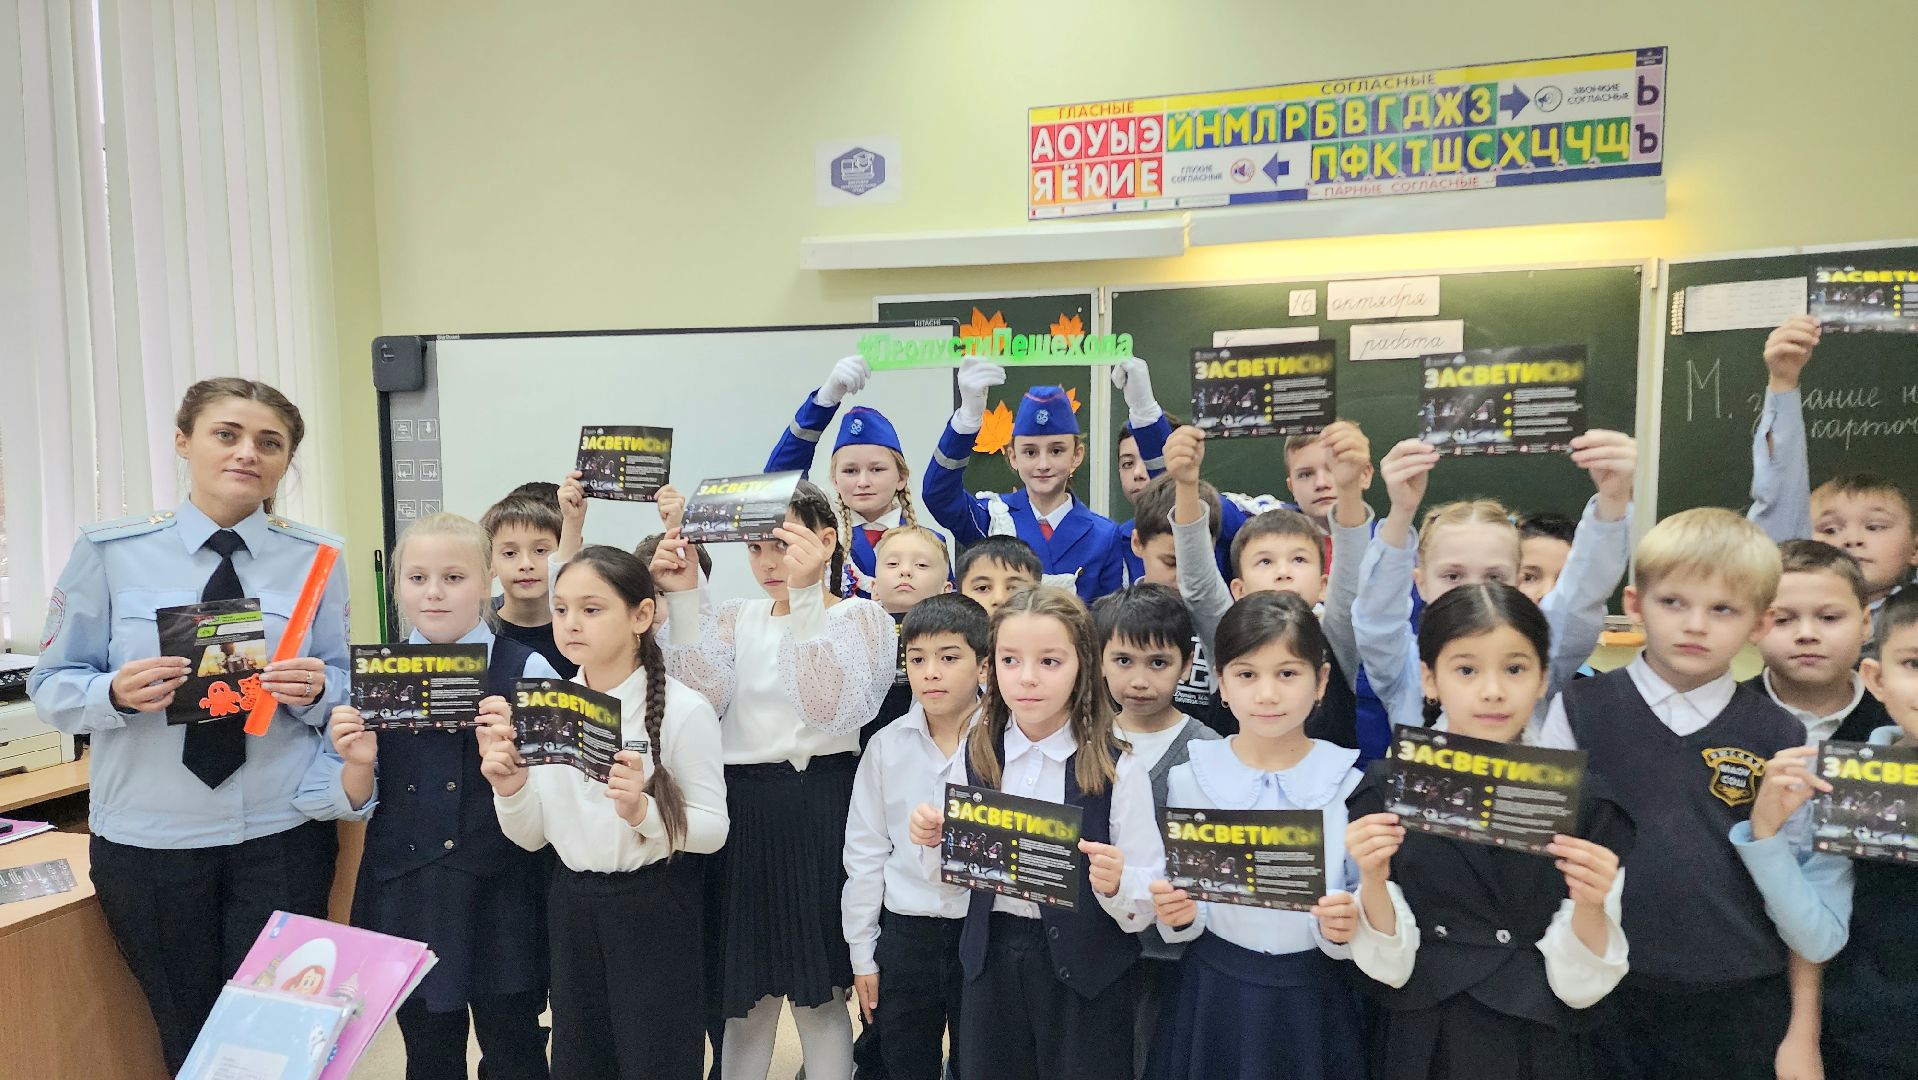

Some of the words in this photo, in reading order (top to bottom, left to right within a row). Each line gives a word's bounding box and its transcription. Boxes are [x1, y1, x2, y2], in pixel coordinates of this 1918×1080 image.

[1320, 73, 1436, 95] СОГЛАСНЫЕ
[1057, 100, 1135, 119] ГЛАСНЫЕ
[1324, 183, 1384, 199] ПАРНЫЕ
[1391, 175, 1480, 194] СОГЛАСНЫЕ
[1291, 291, 1314, 313] 16
[1331, 283, 1427, 316] октября
[914, 319, 941, 327] HITACHI
[1359, 328, 1446, 359] работа
